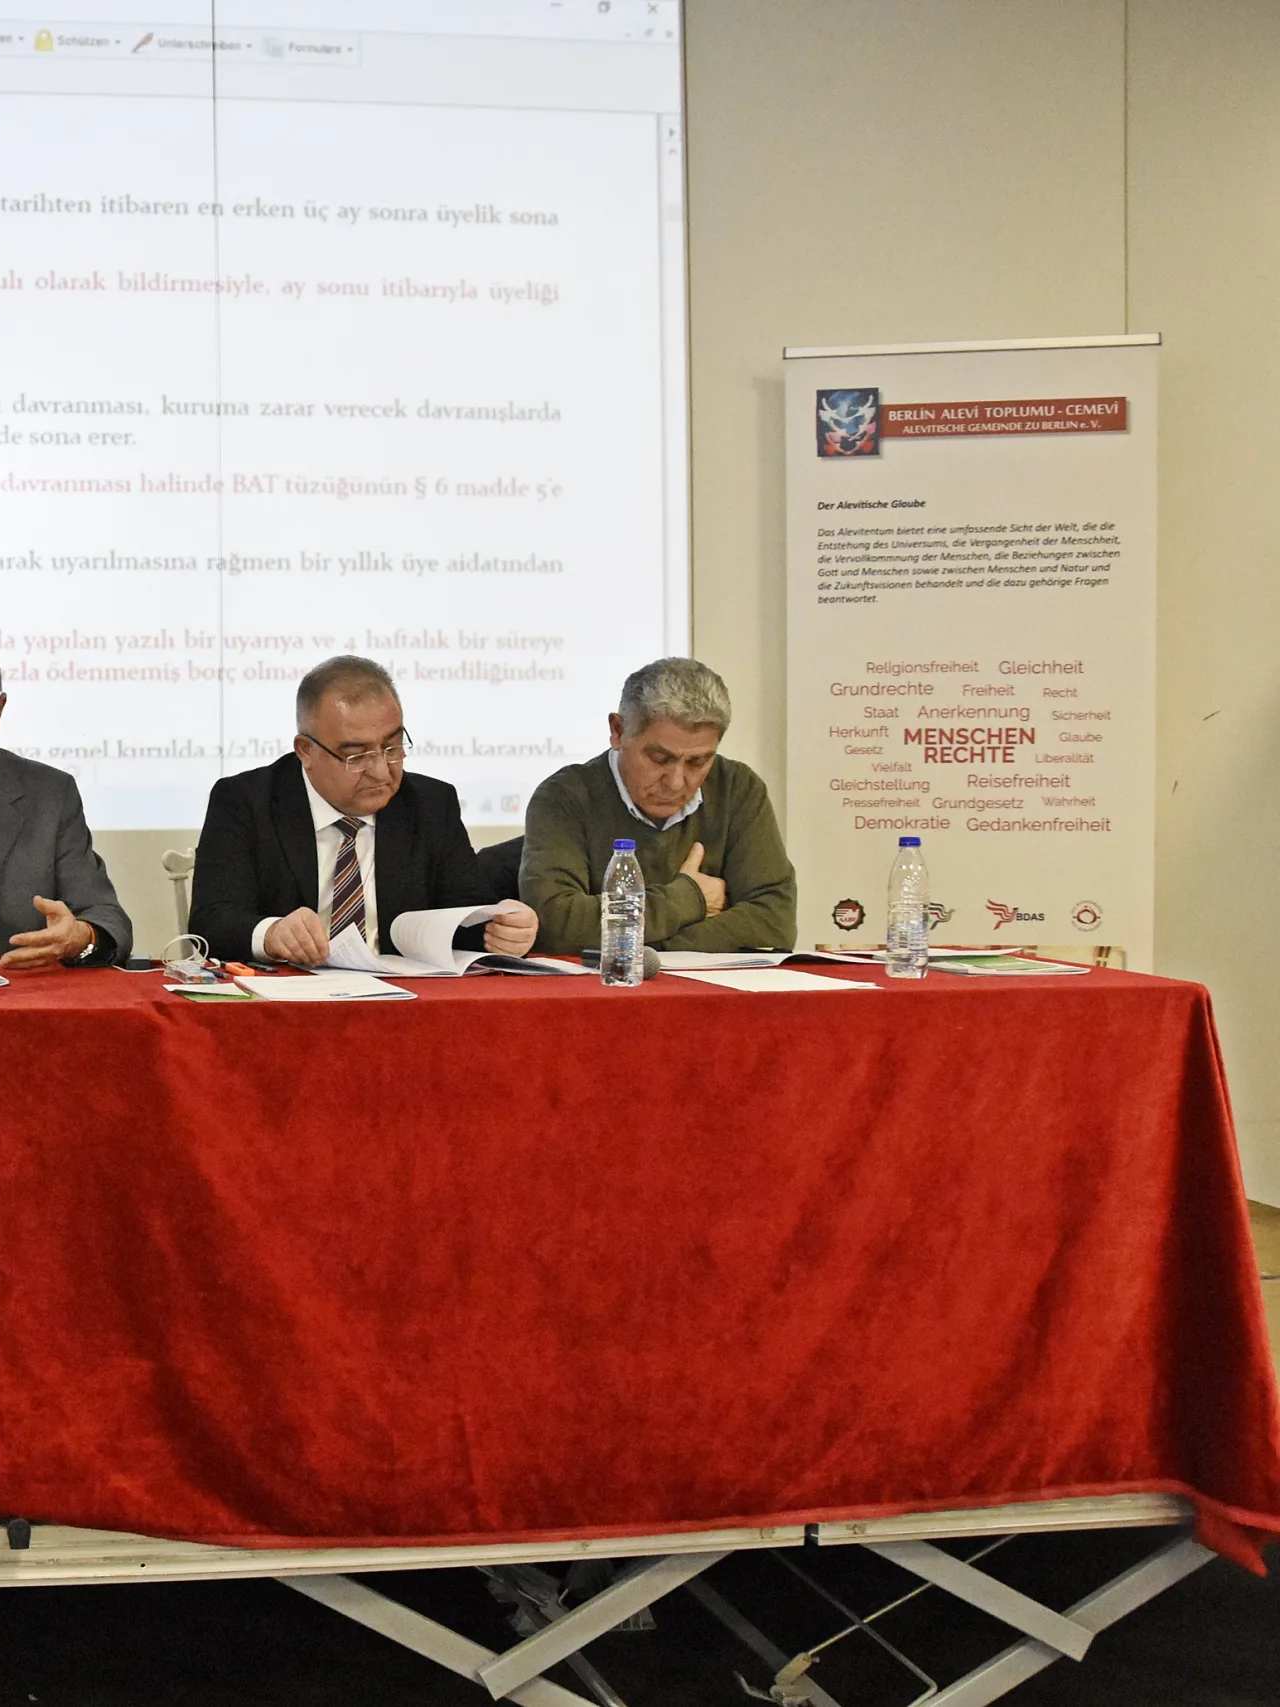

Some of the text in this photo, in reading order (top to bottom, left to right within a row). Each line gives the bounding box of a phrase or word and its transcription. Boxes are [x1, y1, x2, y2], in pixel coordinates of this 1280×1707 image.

[1, 192, 91, 214] tarihten
[101, 193, 189, 216] itibaren
[198, 201, 224, 217] en
[233, 196, 295, 219] erken
[304, 200, 329, 223] üç
[337, 205, 361, 226] ay
[368, 207, 428, 222] sonra
[437, 203, 502, 228] üyelik
[509, 211, 559, 226] sona
[889, 407, 935, 421] BERLİN
[941, 405, 978, 420] ALEVİ
[984, 406, 1054, 418] TOPLUMU
[1065, 401, 1118, 416] CEMEVİ
[902, 420, 1101, 434] ALEVITISCHE GEMEINDE ZU BERLIN e. V.
[817, 499, 926, 510] Der Alevitische Glaube
[866, 661, 979, 676] Religionsfreiheit
[999, 660, 1084, 674] Gleichheit
[830, 681, 934, 696] Grundrechte
[963, 684, 1015, 696] Freiheit
[1043, 688, 1078, 697] Recht
[864, 707, 899, 718] Staat
[917, 705, 1030, 721] Anerkennung
[1052, 711, 1111, 720] Sicherheit
[829, 725, 889, 738] Herkunft
[904, 728, 1036, 745] MENSCHEN
[1059, 732, 1103, 742] Glaube
[844, 745, 883, 755] Gesetz
[924, 746, 1015, 764] RECHTE
[1035, 753, 1095, 763] Liberalität
[872, 762, 912, 772] Vielfalt
[830, 778, 930, 793] Gleichstellung
[968, 774, 1070, 788] Reisefreiheit
[842, 797, 920, 807] Pressefreiheit
[932, 797, 1024, 812] Grundgesetz
[1041, 796, 1096, 807] Wahrheit
[855, 816, 951, 829] Demokratie
[966, 817, 1111, 831] Gedankenfreiheit
[1016, 912, 1045, 921] BDAS
